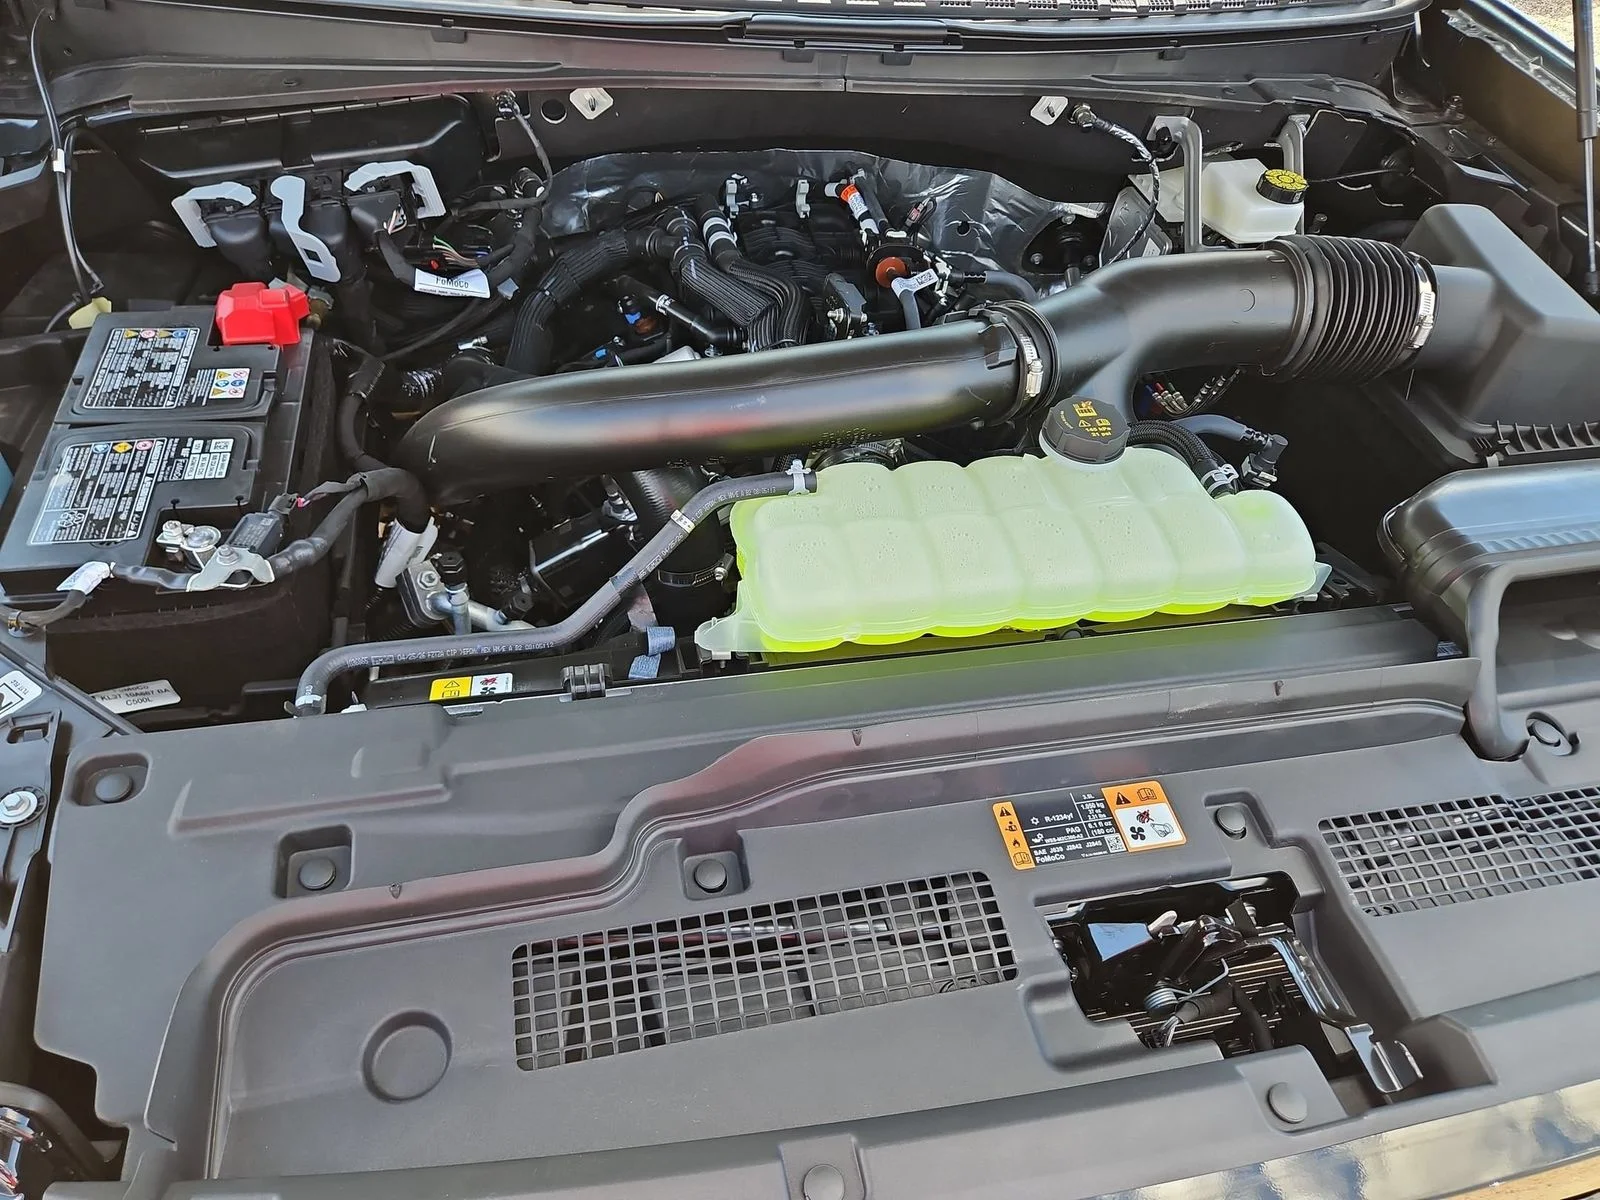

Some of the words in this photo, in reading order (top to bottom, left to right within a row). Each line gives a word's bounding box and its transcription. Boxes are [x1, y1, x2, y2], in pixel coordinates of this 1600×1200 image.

[436, 277, 468, 288] FoMoCo
[397, 651, 425, 661] 04/25/26
[1044, 812, 1073, 823] R-1234yf
[1035, 853, 1065, 863] FoMoCo
